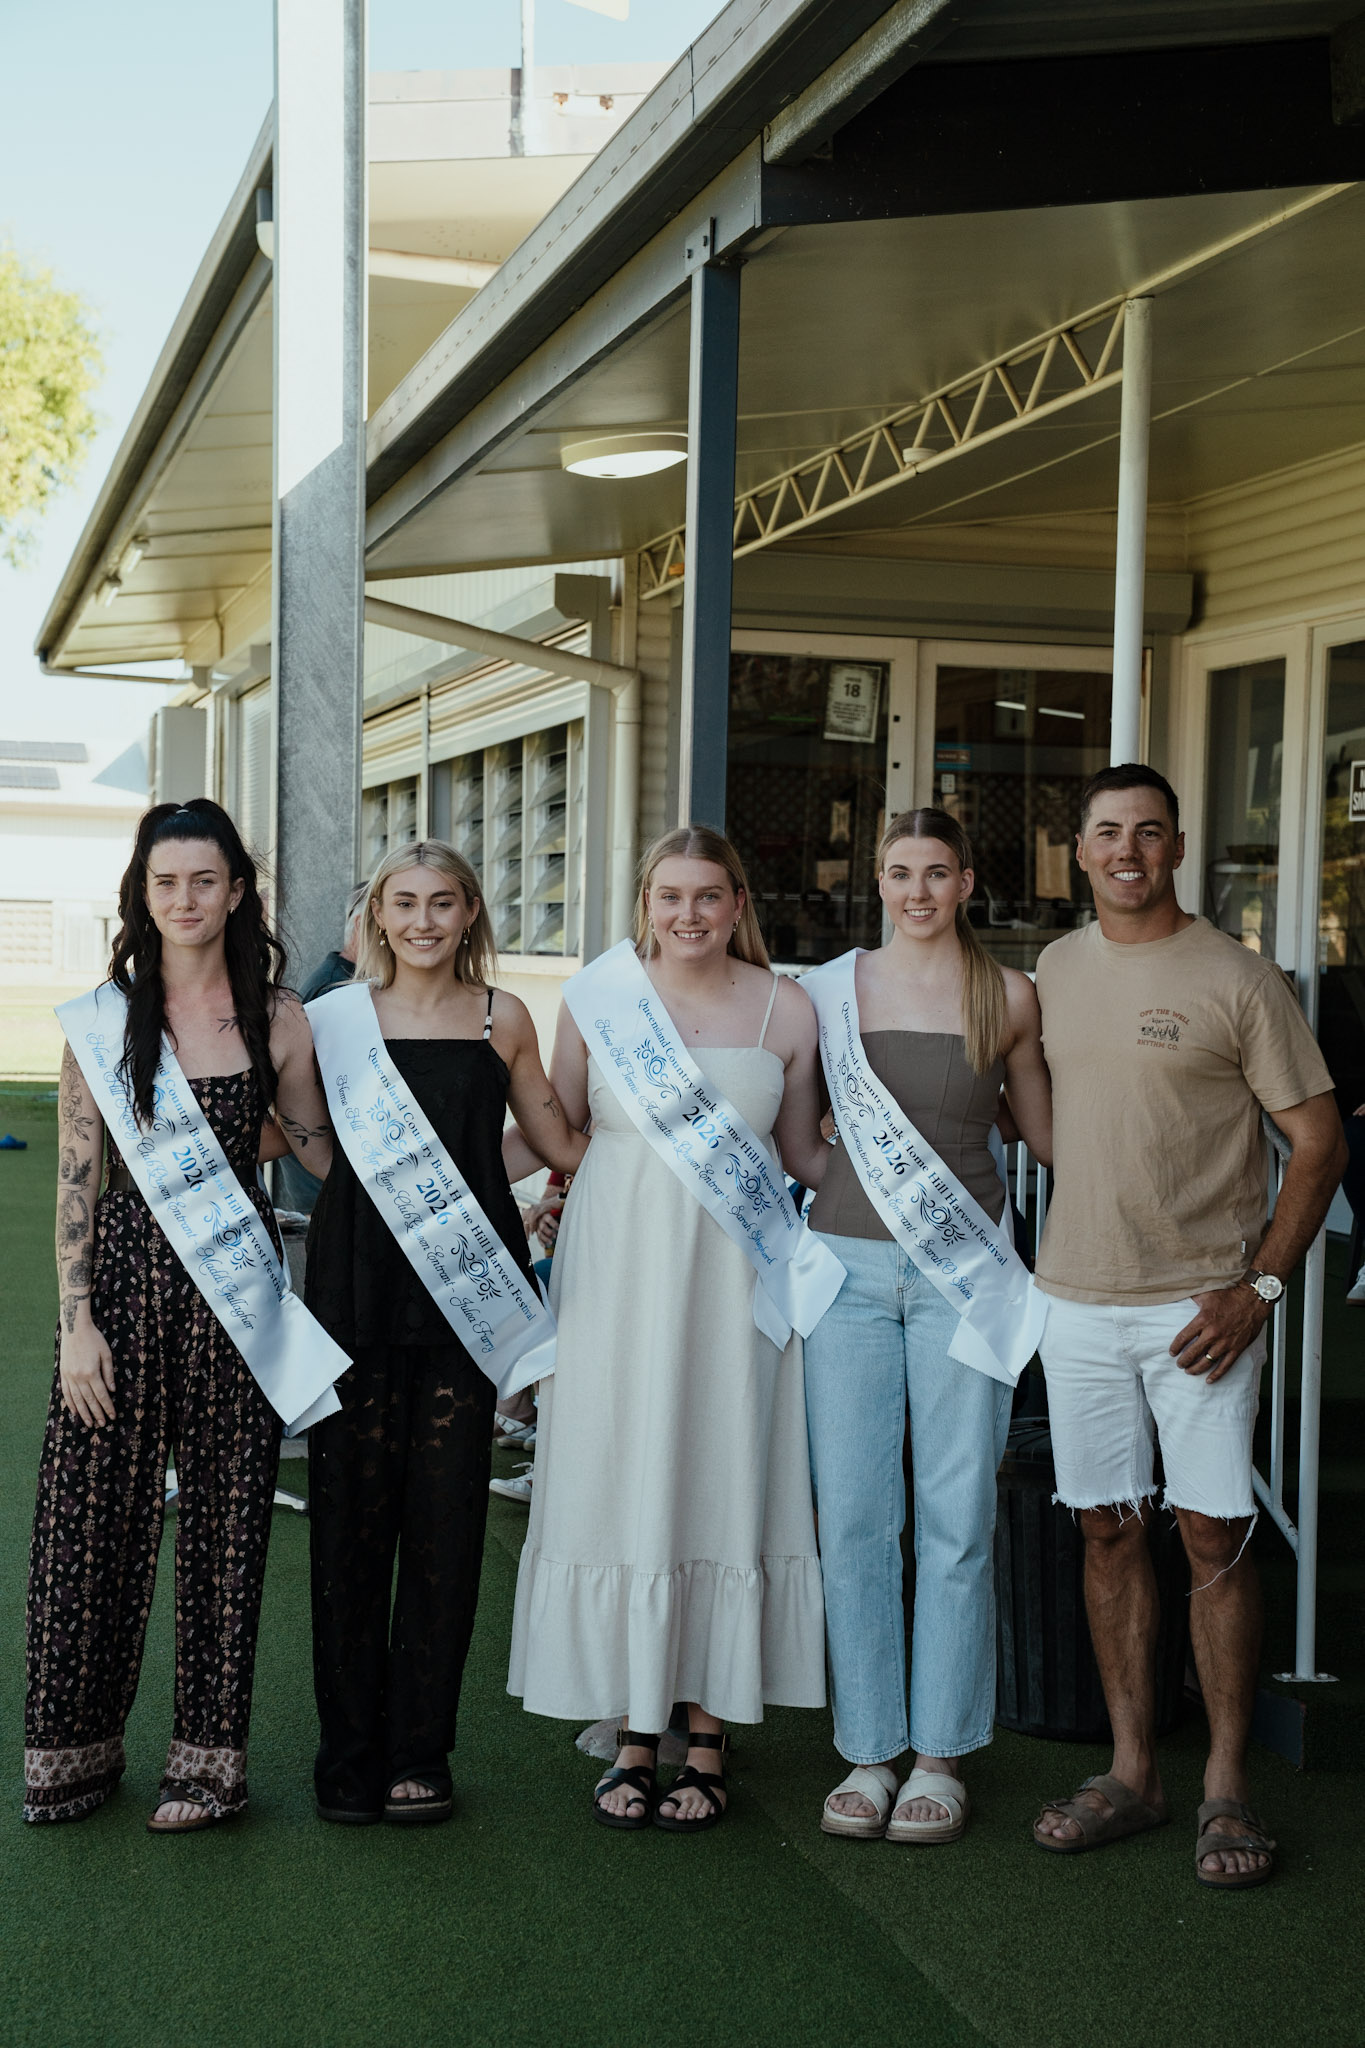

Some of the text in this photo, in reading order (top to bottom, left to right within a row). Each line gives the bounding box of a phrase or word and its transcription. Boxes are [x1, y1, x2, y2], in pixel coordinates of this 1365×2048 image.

[844, 683, 860, 698] 18
[1140, 1009, 1153, 1017] OFF
[86, 1032, 110, 1069] Home
[1137, 1039, 1165, 1048] RHYTHM
[104, 1071, 126, 1096] Hill
[336, 1074, 350, 1107] Home
[345, 1107, 368, 1133] Hill
[594, 1019, 615, 1047] Home
[609, 1046, 631, 1068] Hill
[622, 1063, 640, 1095] Tennis
[638, 1095, 679, 1145] Association
[674, 1140, 701, 1171] Queen
[699, 1163, 729, 1201] Entrant
[727, 1205, 757, 1232] Sarah
[638, 998, 794, 1231] Queensland Country Bank Home Hill Harvest Festival
[682, 1105, 725, 1149] 2026
[841, 1001, 1008, 1266] Queensland Country Bank Home Hill Harvest Festival
[137, 1136, 163, 1167] Club
[171, 1145, 208, 1193] 2026
[831, 1074, 851, 1112] Netball
[843, 1113, 871, 1168] Association
[866, 1166, 891, 1198] Queen
[888, 1191, 918, 1233] Entrant
[914, 1239, 950, 1267] Sarah
[872, 1129, 911, 1175] 2026
[147, 1160, 172, 1200] Queen
[165, 1079, 286, 1302] Country Bank Home Hill Harvest Festival
[368, 1047, 537, 1321] Queensland Country Bank Home Hill Harvest Festival
[373, 1165, 396, 1194] Lions
[167, 1194, 200, 1239] Entrant
[394, 1190, 418, 1219] Club
[416, 1177, 455, 1225] 2026
[404, 1213, 430, 1251] Queen
[195, 1246, 232, 1284] Maddi
[426, 1245, 455, 1286] Entrant
[214, 1281, 257, 1330] Gallagher
[472, 1320, 496, 1354] Farry
